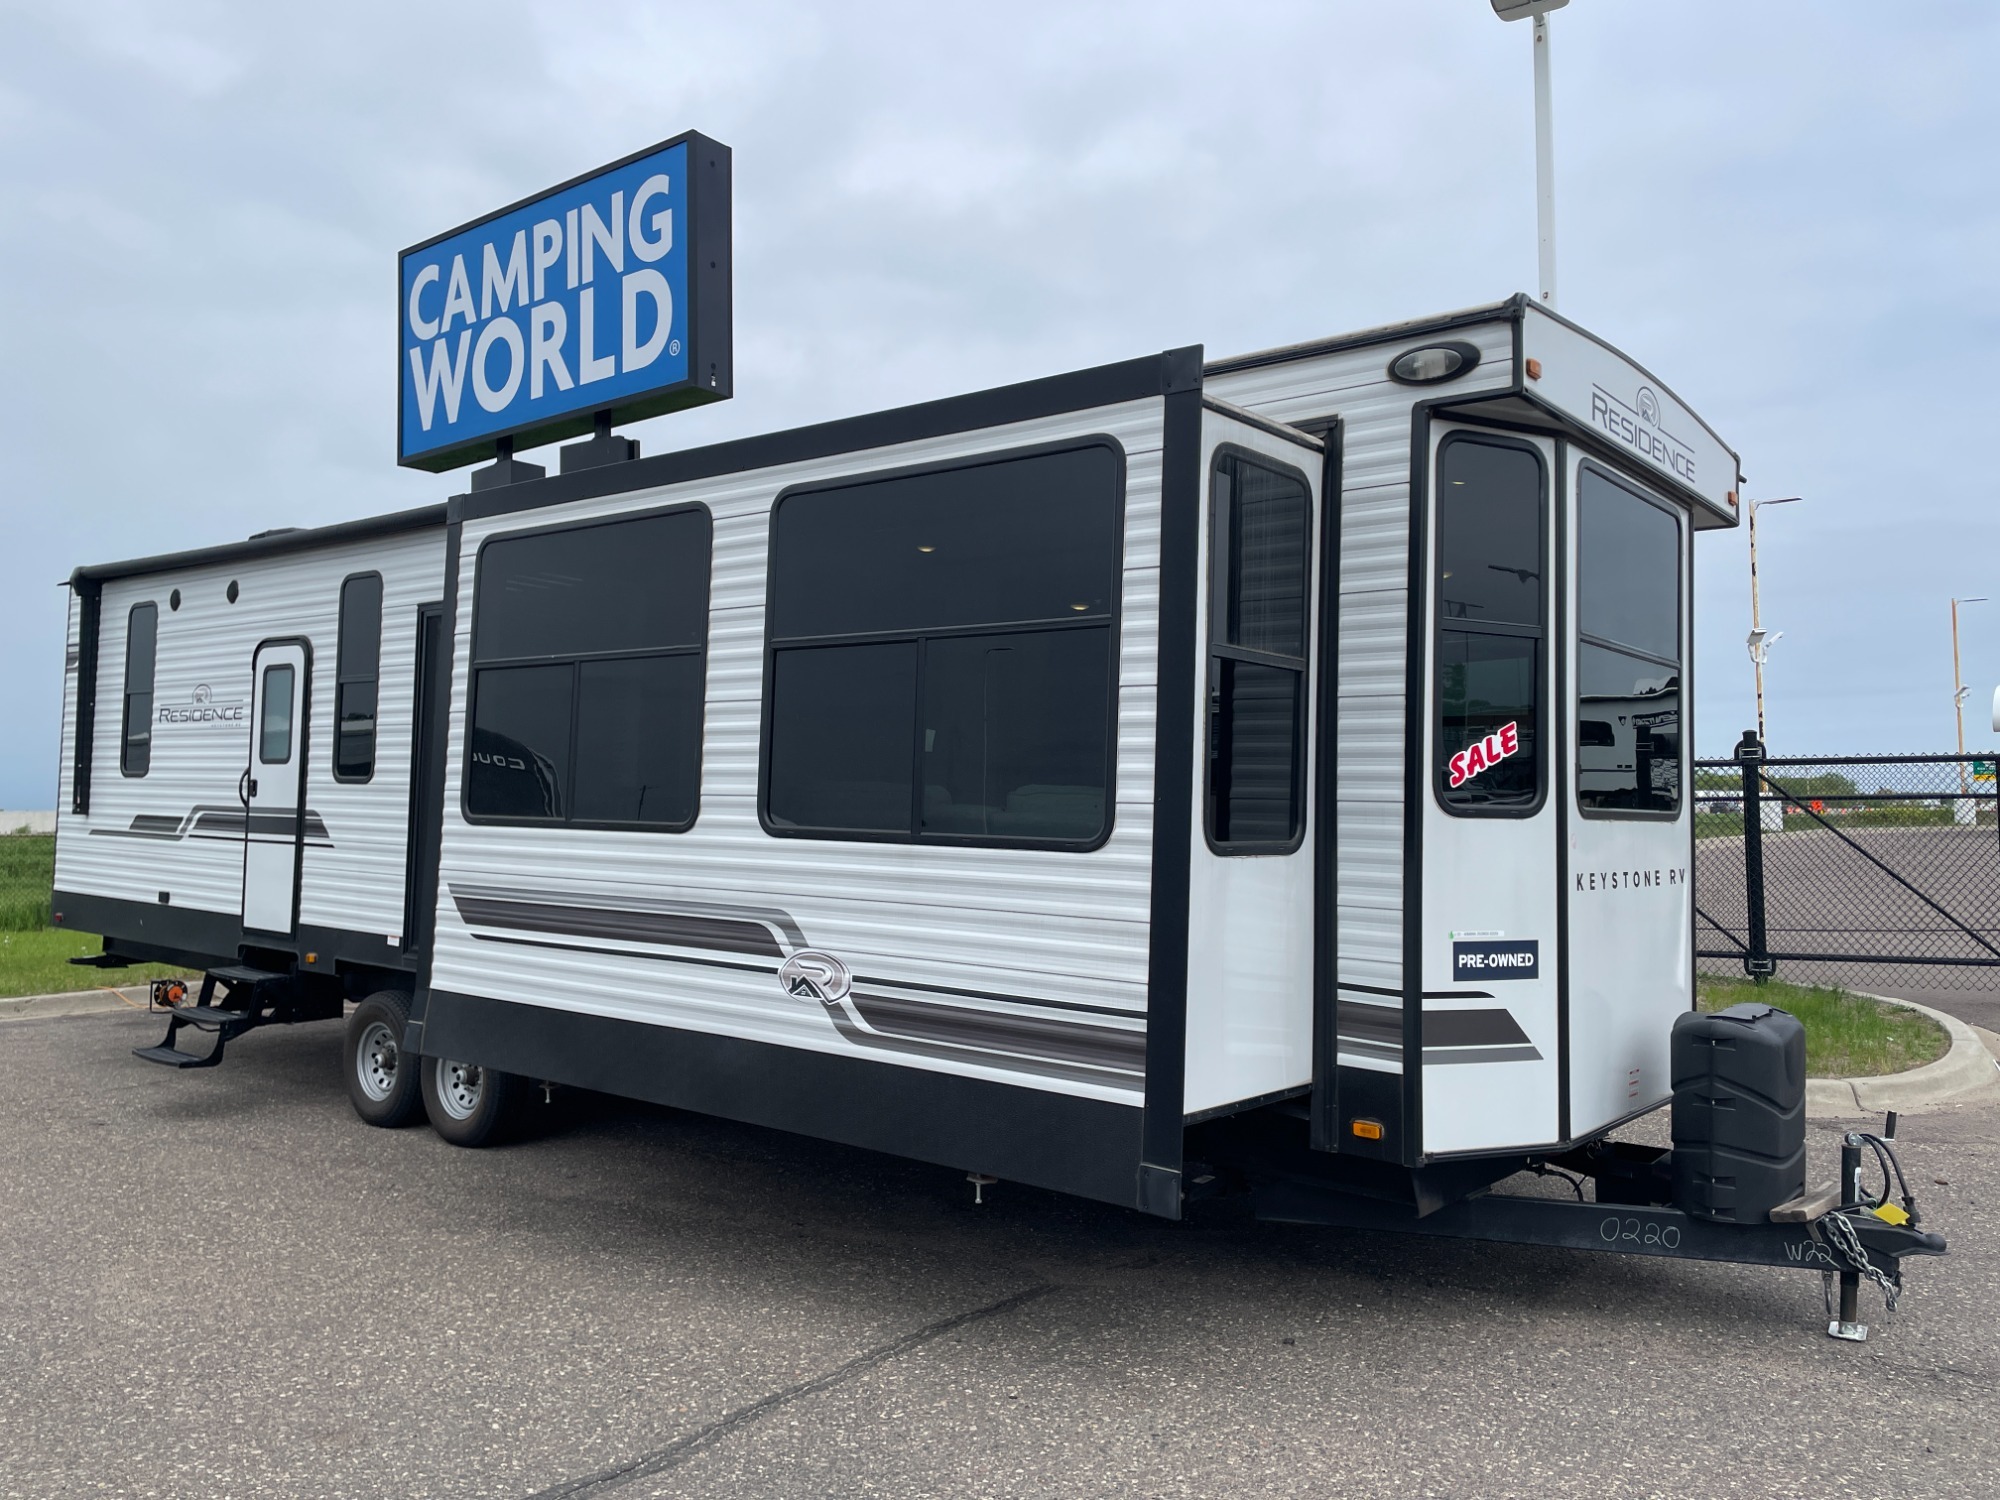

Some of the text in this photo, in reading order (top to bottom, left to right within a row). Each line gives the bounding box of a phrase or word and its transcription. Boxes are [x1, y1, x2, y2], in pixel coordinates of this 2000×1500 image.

[409, 173, 673, 341] CAMPING
[1592, 391, 1695, 484] RESIDENCE
[159, 707, 243, 723] RESIDENCE
[1450, 722, 1518, 788] SALE
[1576, 868, 1685, 891] KEYSTONE RV
[1458, 953, 1534, 968] PRE-OWNED
[1600, 1217, 1681, 1249] 0220
